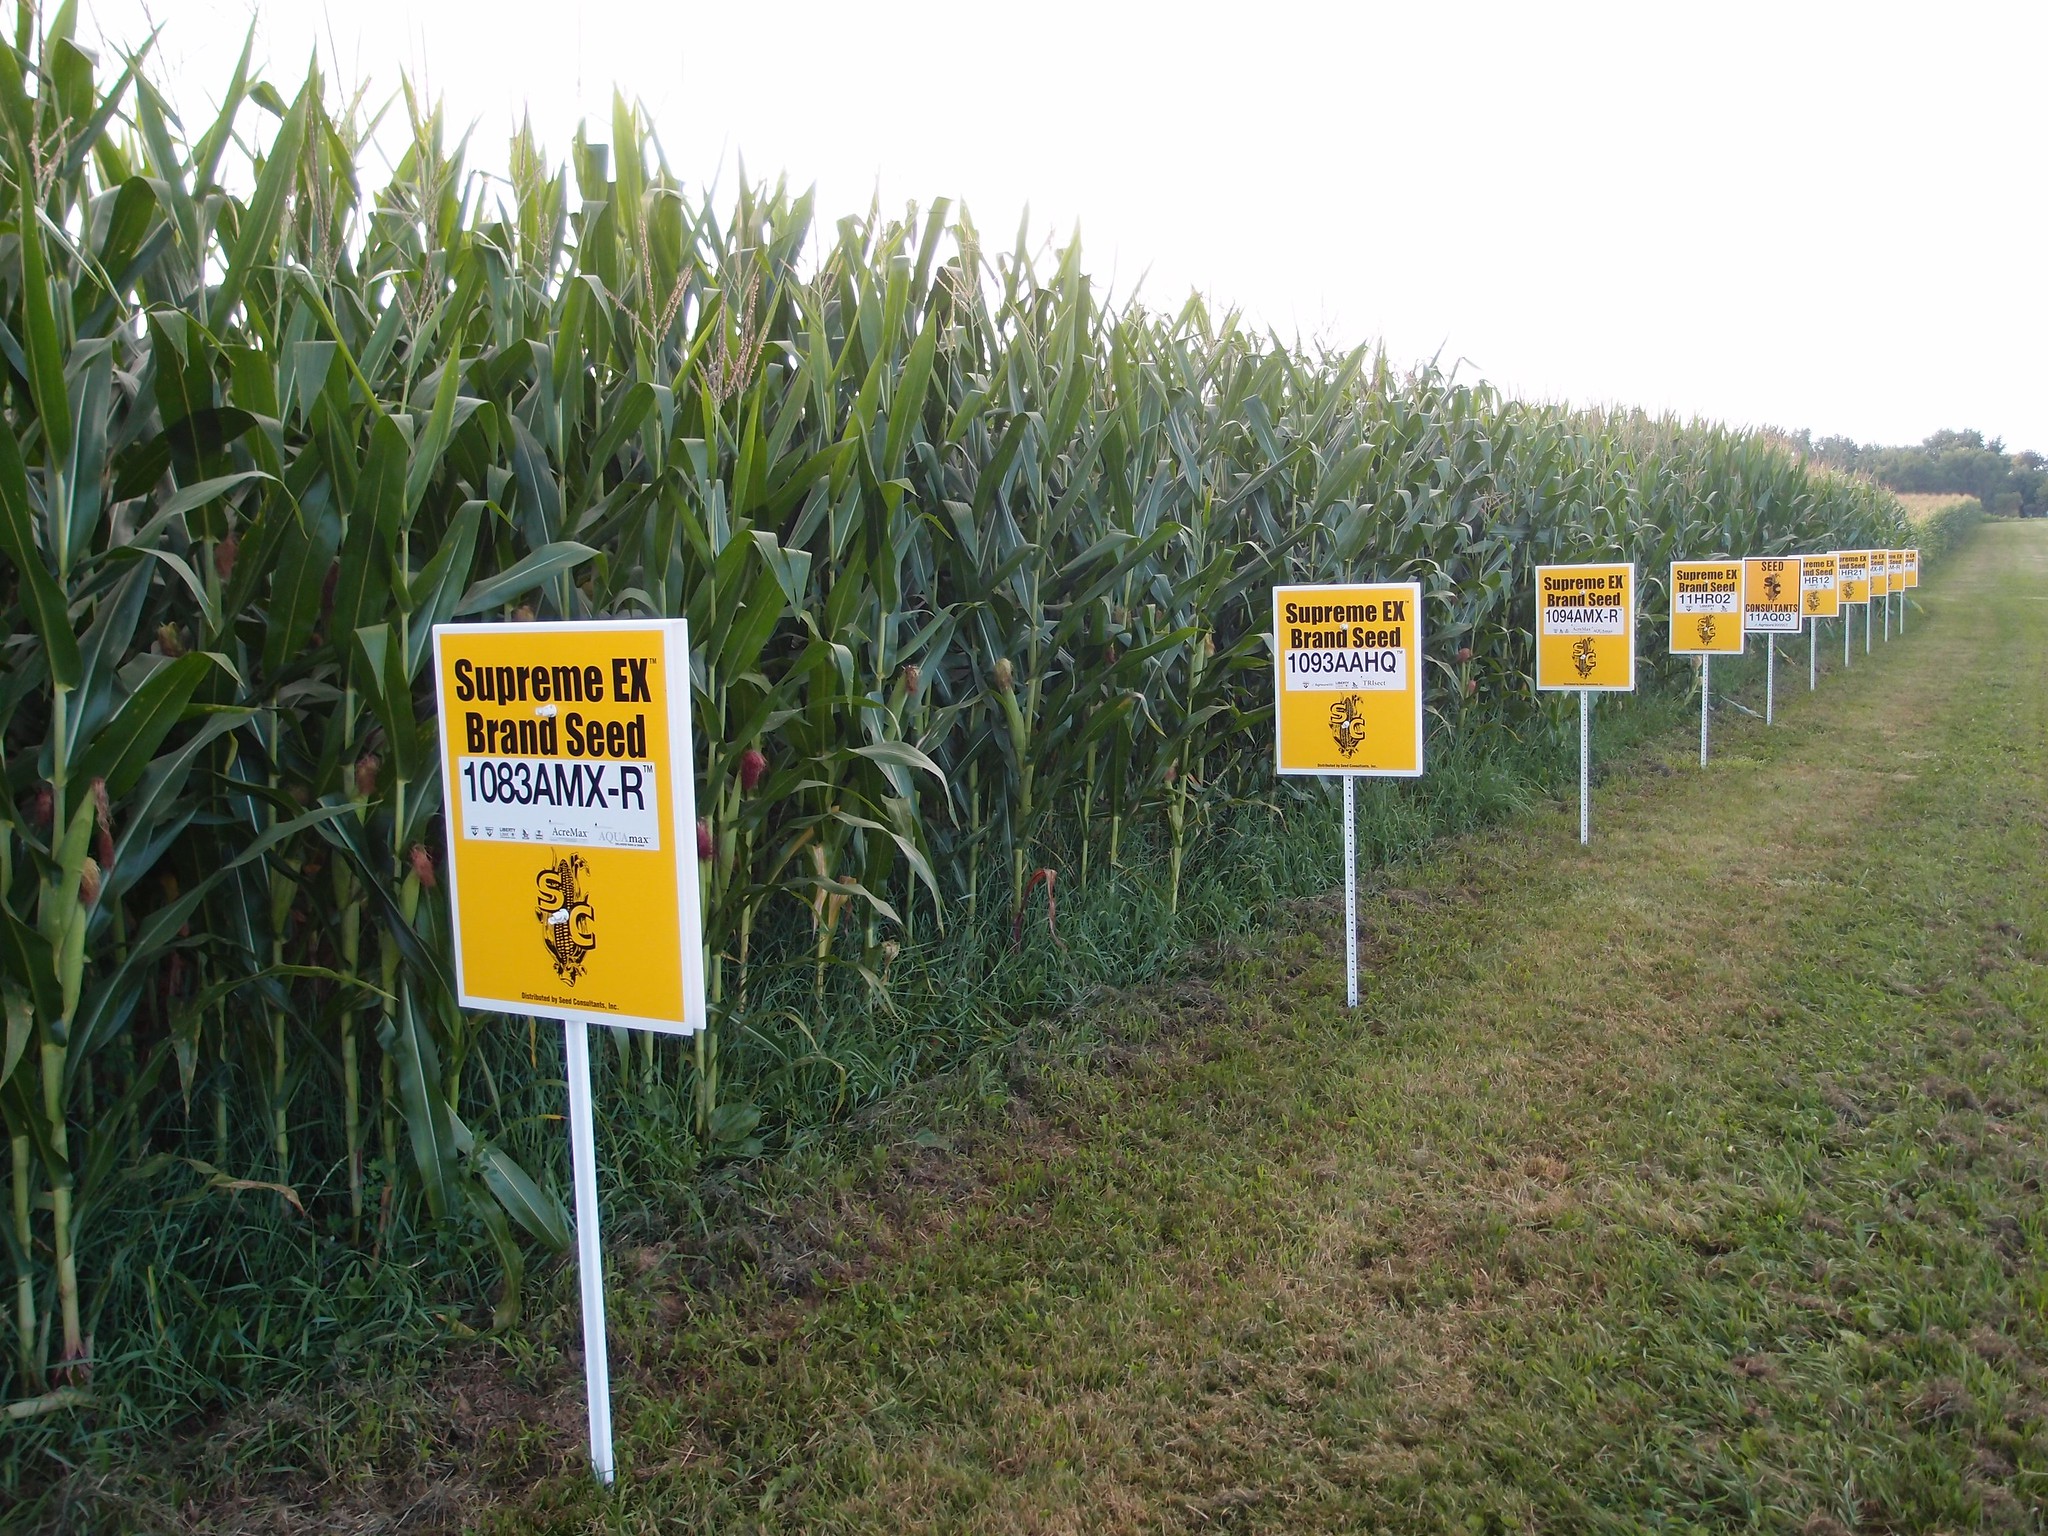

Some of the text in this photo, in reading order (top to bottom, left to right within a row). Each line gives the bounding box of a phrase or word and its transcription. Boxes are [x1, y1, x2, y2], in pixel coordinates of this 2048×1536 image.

[1761, 561, 1784, 571] SEED
[1676, 569, 1737, 581] Supreme EX
[1544, 577, 1604, 591] Supreme
[1679, 582, 1735, 592] Brand Seed
[1547, 593, 1620, 607] Brand Seed
[1679, 594, 1731, 604] 11HR02
[1285, 603, 1377, 625] Supreme
[1745, 604, 1798, 612] CONSULTANTS
[1749, 613, 1792, 622] 11AQ03
[1291, 627, 1400, 649] Brand Seed
[454, 658, 604, 706] Supreme
[465, 711, 647, 758] Brand Seed
[521, 992, 550, 1002] Distributed
[551, 996, 558, 1004] by
[559, 996, 572, 1005] Seed
